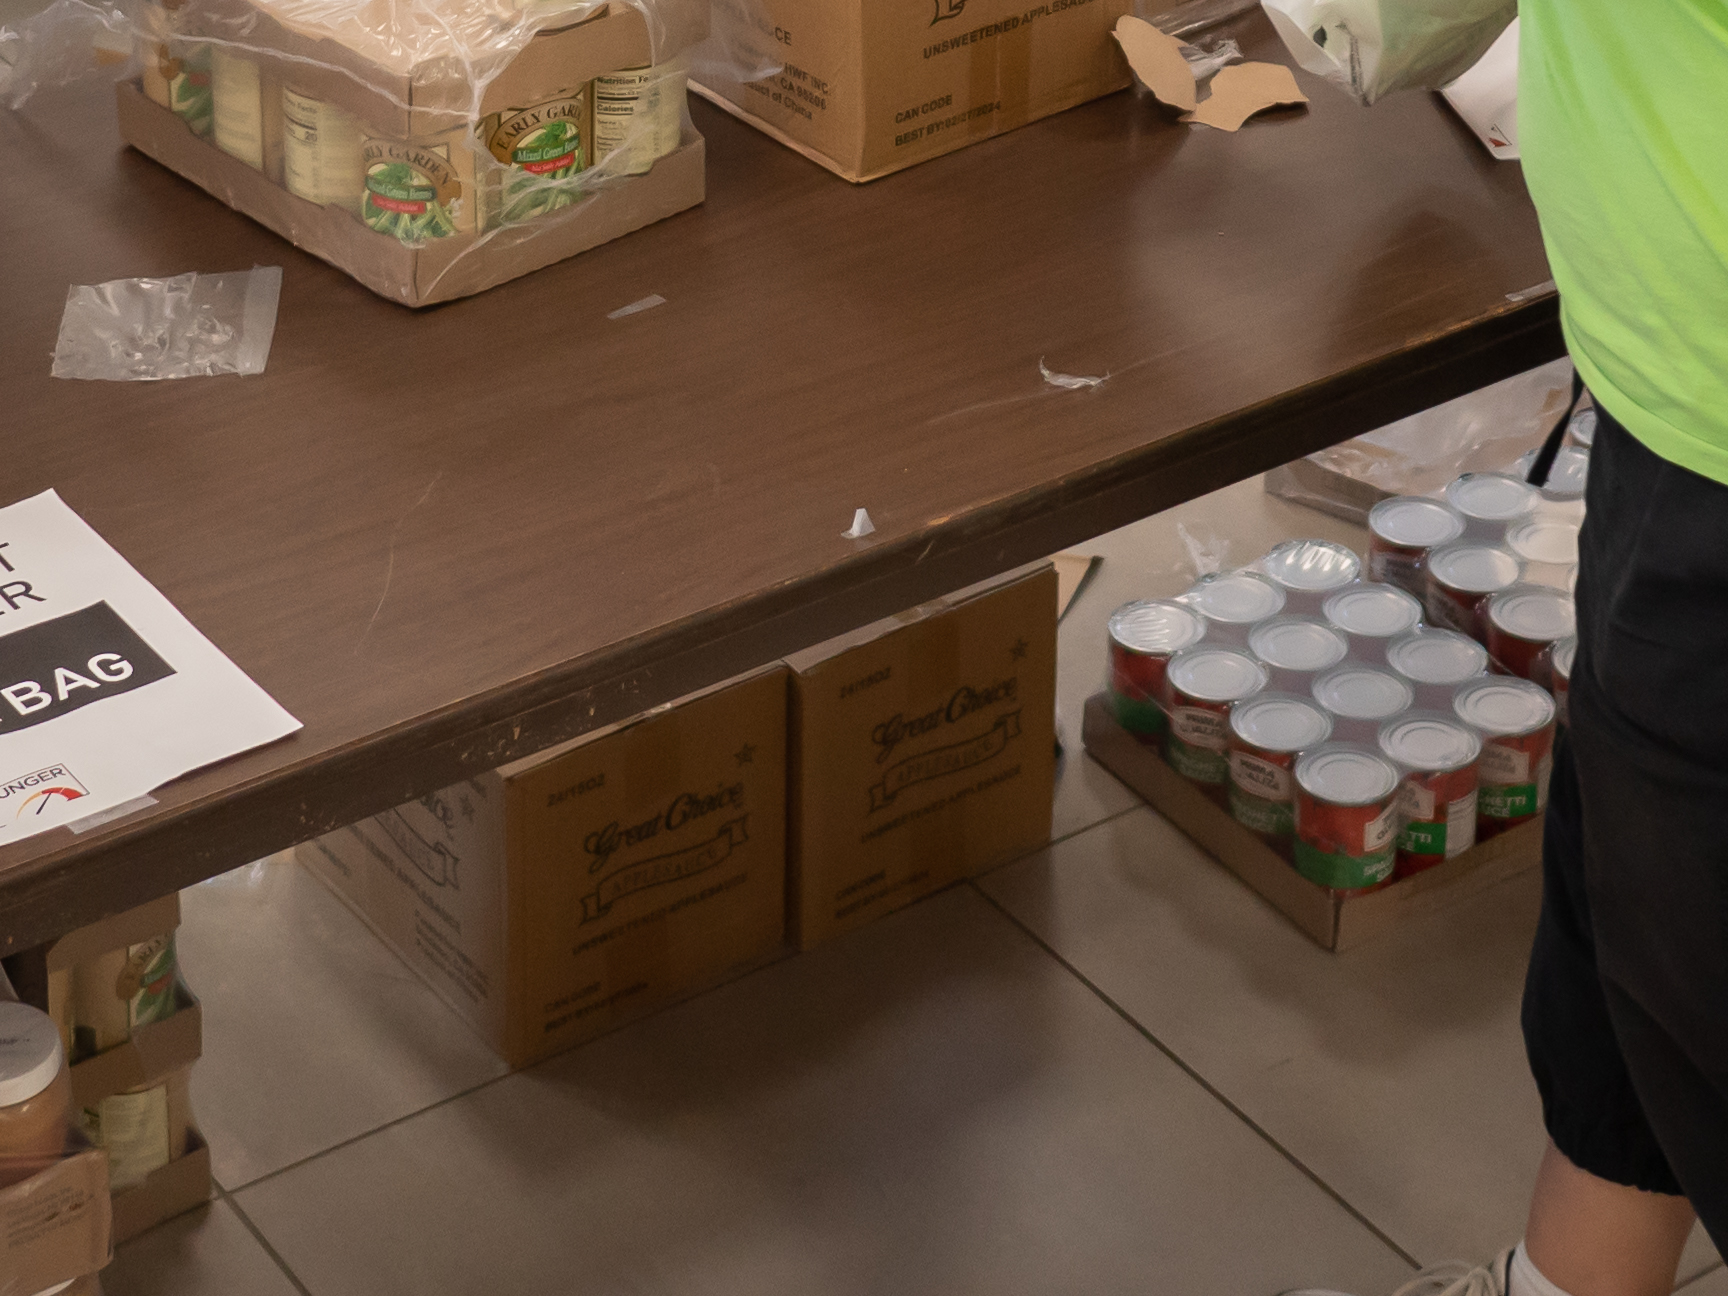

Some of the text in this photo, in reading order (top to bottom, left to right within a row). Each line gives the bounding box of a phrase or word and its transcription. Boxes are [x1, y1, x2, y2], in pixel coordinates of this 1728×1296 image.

[922, 17, 1020, 60] UNSWEETENED
[595, 103, 635, 114] Calories
[894, 94, 954, 126] CAN CODE
[495, 109, 543, 151] EARLY
[894, 127, 926, 148] BEST
[387, 143, 450, 187] GARDEN
[0, 652, 135, 716] BAG
[582, 781, 744, 875] Great Choice
